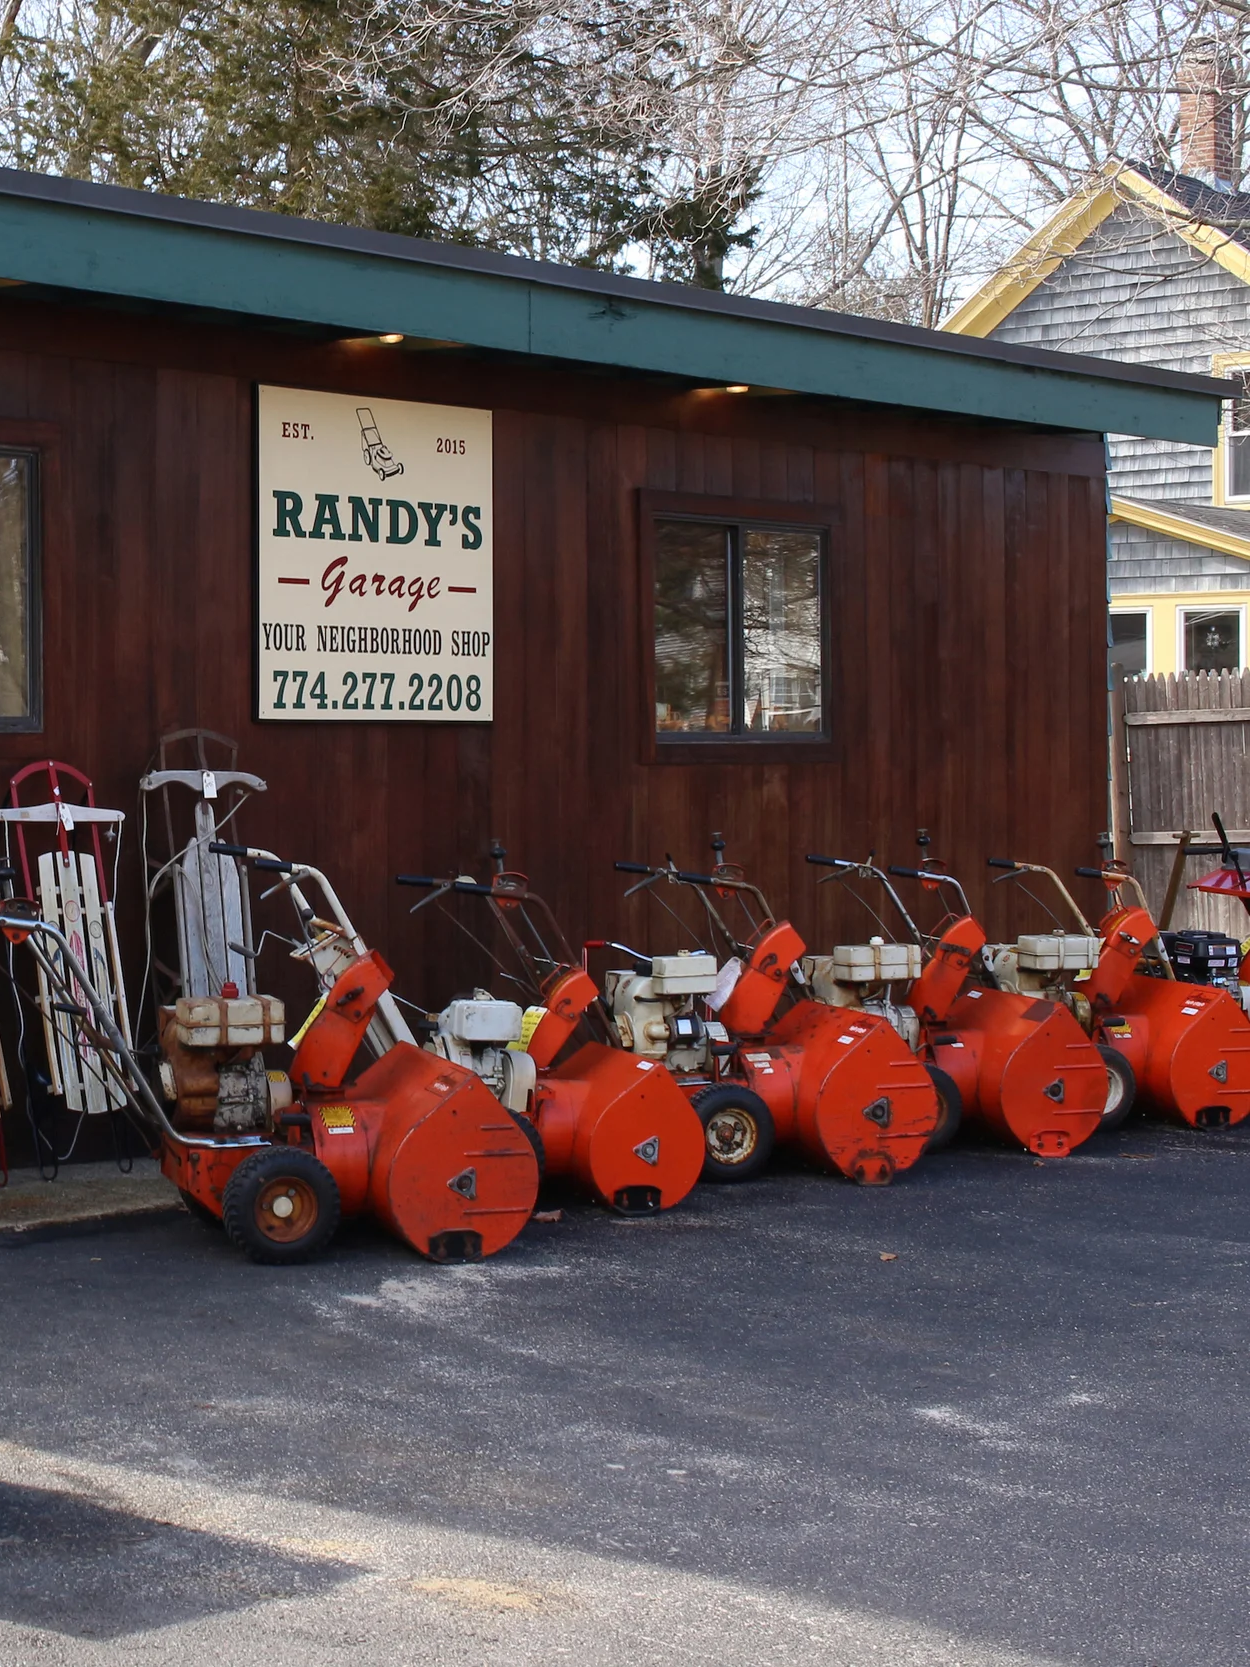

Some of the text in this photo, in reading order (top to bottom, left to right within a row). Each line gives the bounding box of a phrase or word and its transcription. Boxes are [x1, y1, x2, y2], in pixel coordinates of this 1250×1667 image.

[281, 422, 315, 441] EST.
[436, 437, 466, 455] 2015
[272, 490, 483, 550] RANDY'S
[321, 556, 441, 612] Garage
[262, 623, 490, 657] YOUR NEIGHBORHOOD SHOP
[272, 670, 482, 712] 774.277.2208
